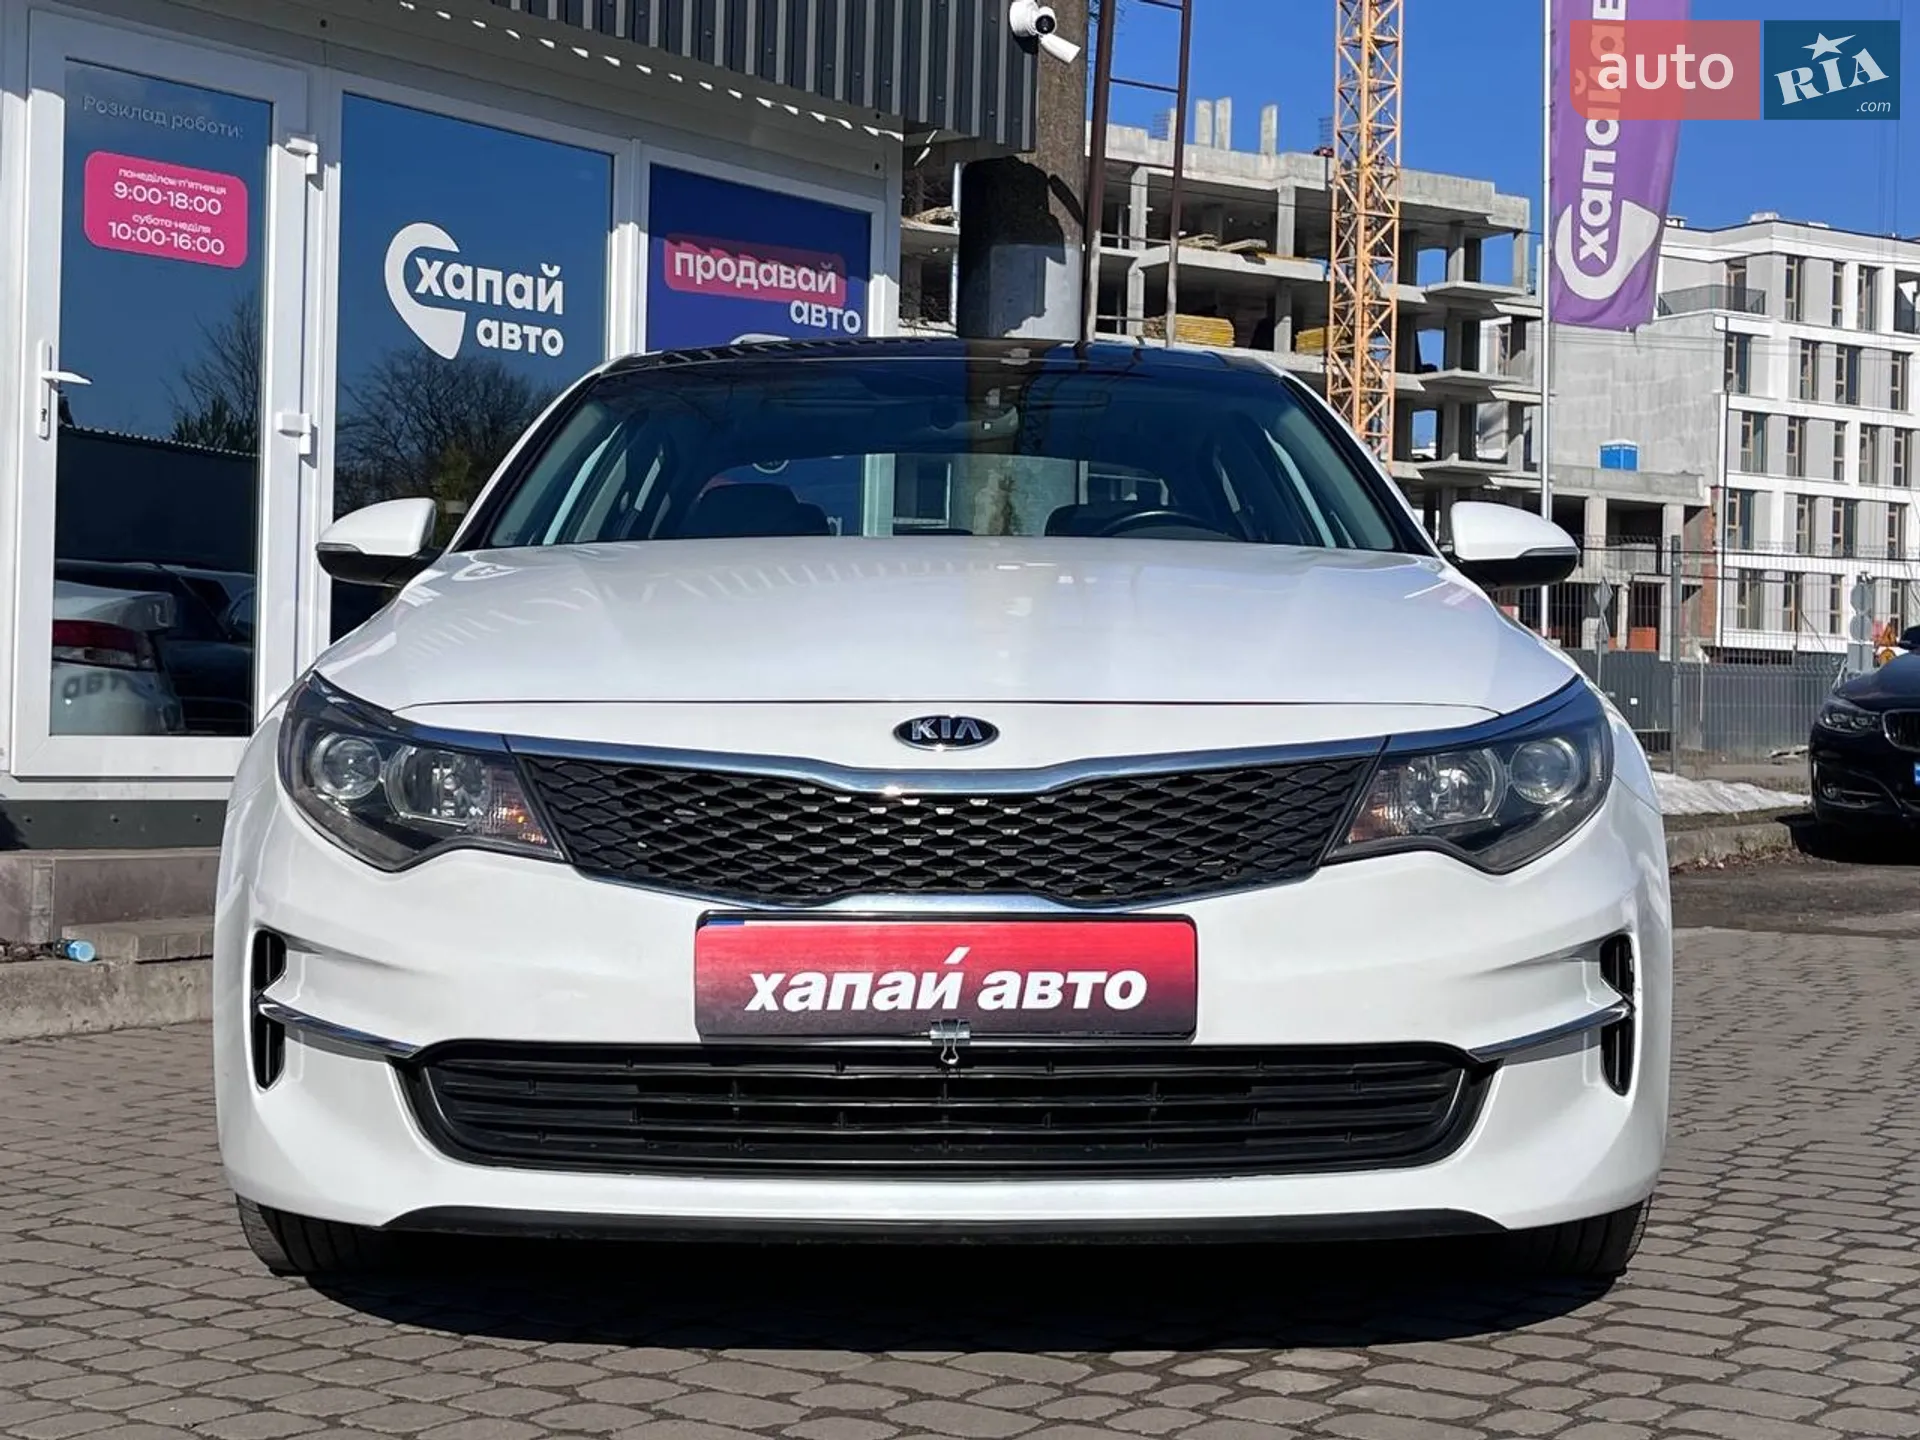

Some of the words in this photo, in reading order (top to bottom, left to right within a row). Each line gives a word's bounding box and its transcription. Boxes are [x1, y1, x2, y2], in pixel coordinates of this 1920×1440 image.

[83, 95, 167, 127] Розклад
[113, 181, 222, 215] 9:00-18:00
[108, 221, 225, 255] 10:00-16:00
[415, 256, 564, 315] хапай
[674, 251, 837, 294] продавай
[790, 300, 861, 334] авто
[476, 318, 564, 357] авто
[911, 718, 983, 740] KIA
[977, 970, 1148, 1011] авто
